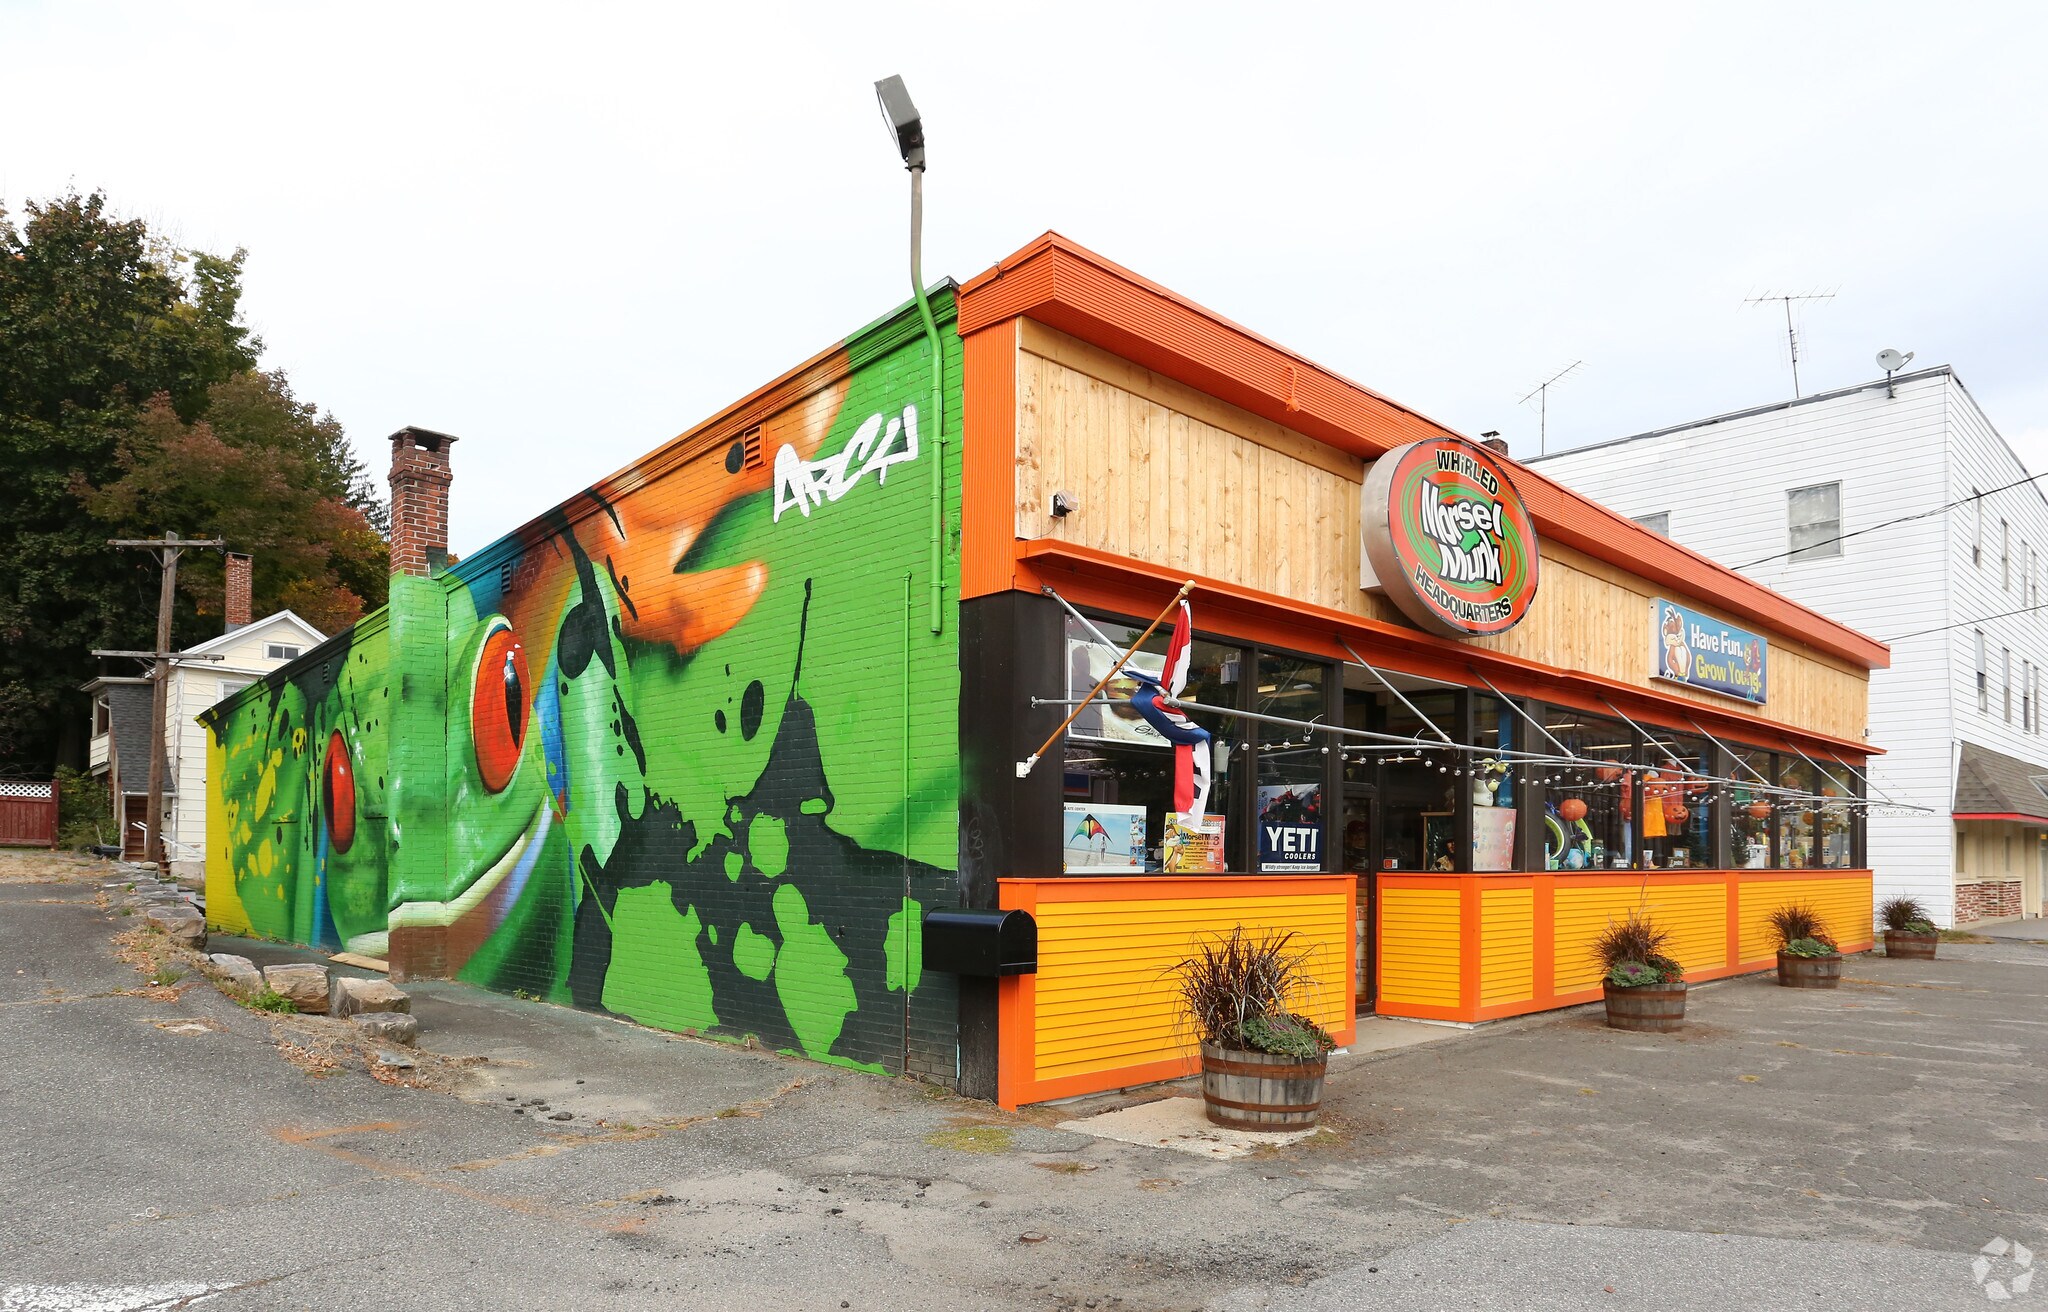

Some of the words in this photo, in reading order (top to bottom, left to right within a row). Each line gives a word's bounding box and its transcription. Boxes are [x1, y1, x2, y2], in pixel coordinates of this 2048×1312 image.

[1422, 478, 1504, 546] Morsel
[1439, 530, 1503, 585] Munk
[1415, 563, 1512, 621] HEADQUARTERS
[1690, 623, 1719, 652] Have
[1695, 654, 1727, 681] Grow
[1266, 827, 1317, 852] YETI
[1284, 852, 1316, 860] COOLERS
